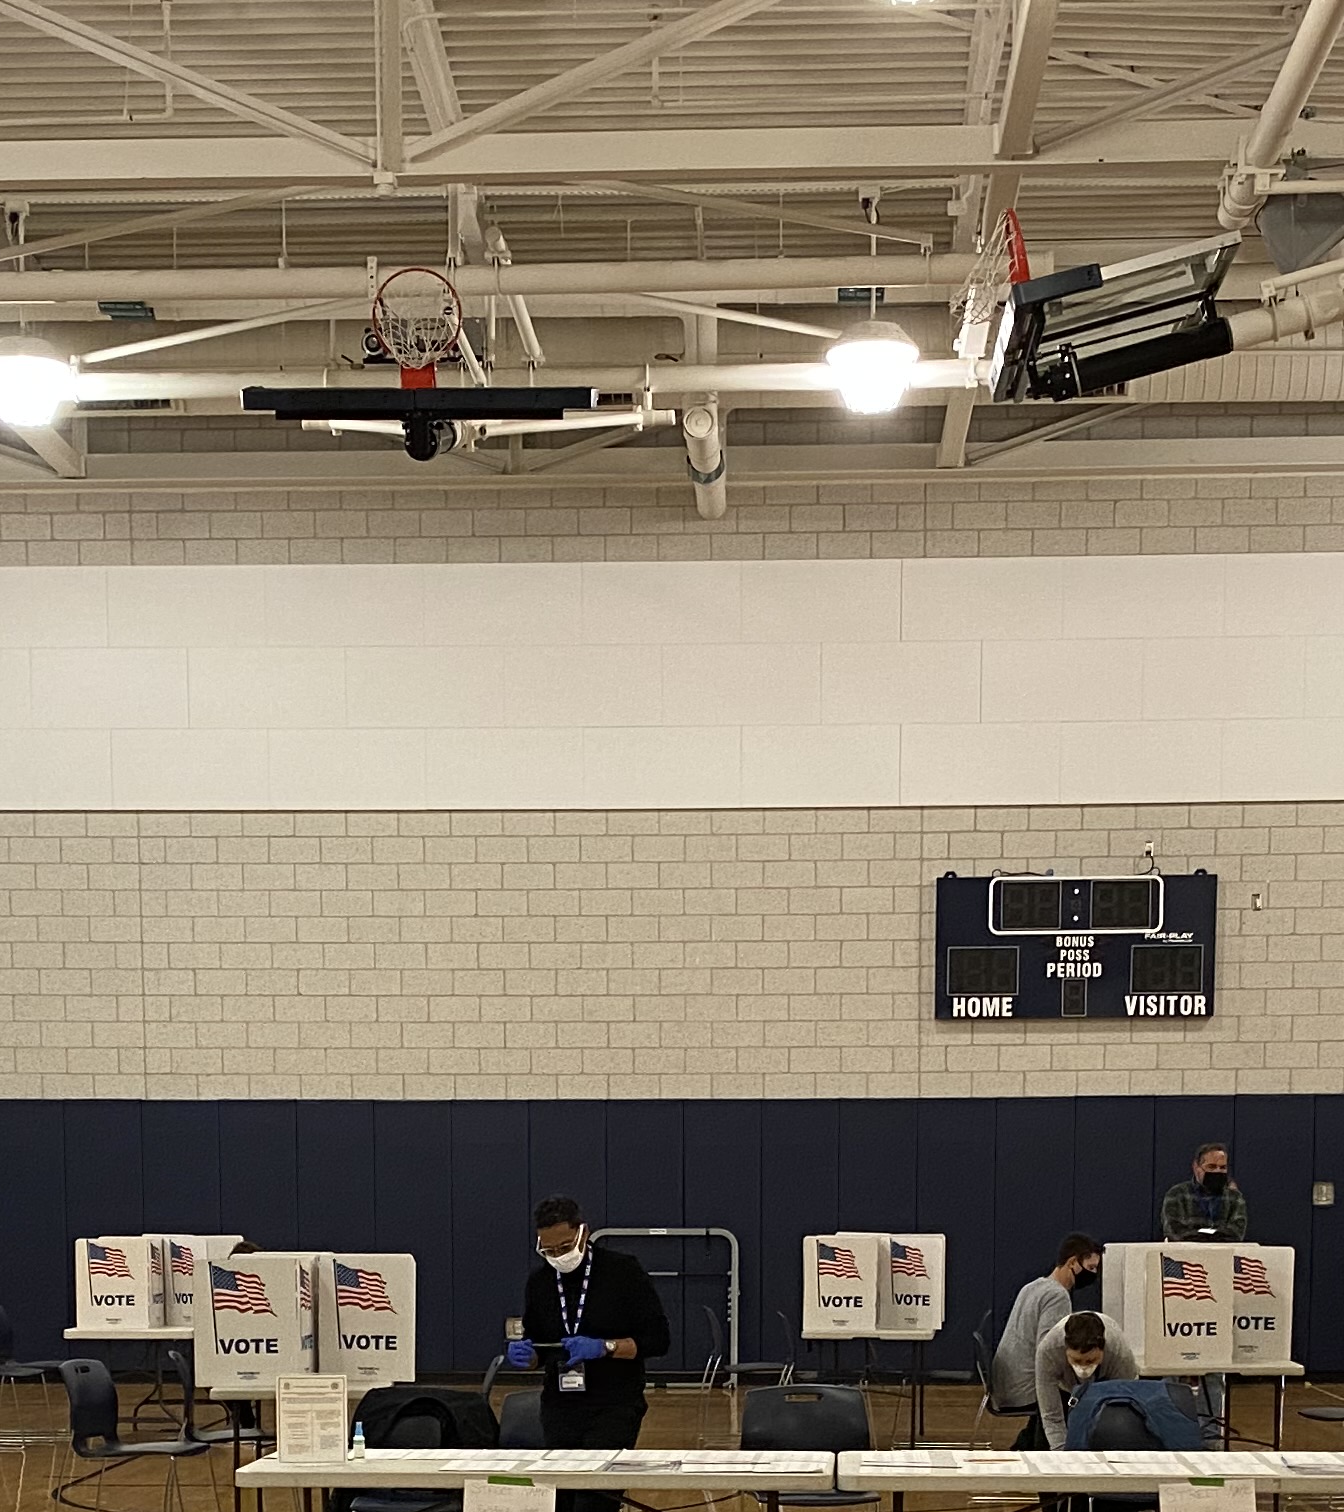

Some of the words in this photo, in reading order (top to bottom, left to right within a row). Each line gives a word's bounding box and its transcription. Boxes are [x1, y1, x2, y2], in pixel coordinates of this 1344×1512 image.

[1055, 936, 1095, 948] BONUS
[1059, 950, 1090, 961] POSS
[1046, 963, 1102, 978] PERIOD
[952, 997, 1013, 1018] HOME
[1125, 996, 1206, 1016] VISITOR
[93, 1294, 135, 1306] VOTE
[175, 1293, 193, 1305] VOT
[821, 1296, 863, 1308] VOTE
[895, 1293, 930, 1306] VOTE
[1167, 1322, 1217, 1337] VOTE
[219, 1338, 278, 1354] VOTE
[342, 1334, 397, 1350] VOTE
